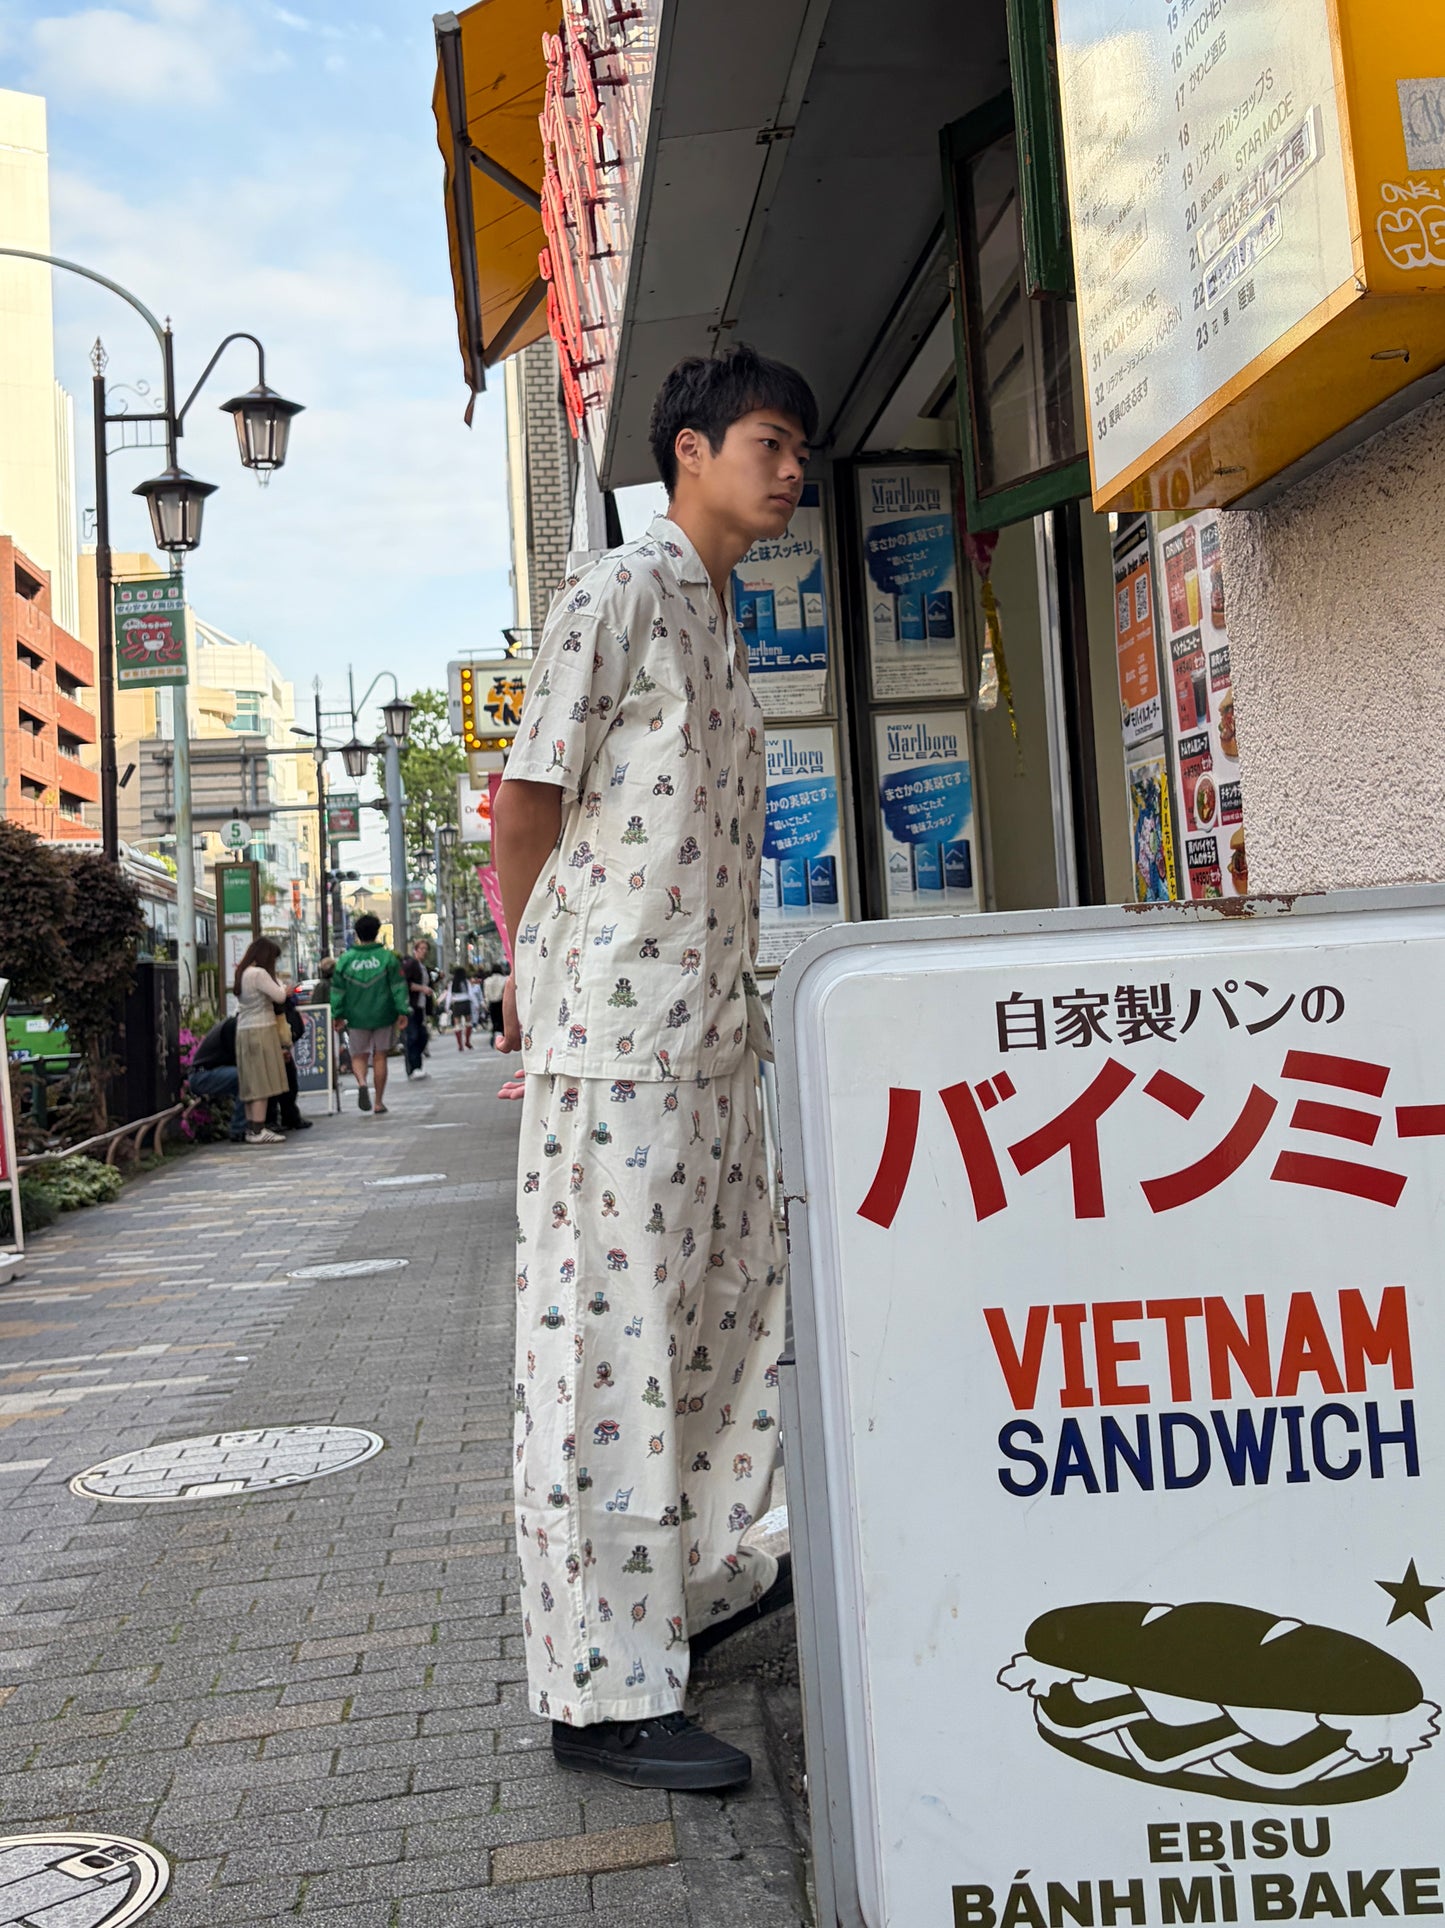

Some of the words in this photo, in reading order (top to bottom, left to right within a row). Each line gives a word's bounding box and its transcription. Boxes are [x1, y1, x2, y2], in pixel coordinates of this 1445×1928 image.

[1170, 45, 1182, 73] 16
[1175, 83, 1185, 112] 17
[1179, 123, 1189, 151] 18
[1185, 201, 1197, 232] 20
[1235, 131, 1261, 171] STAR
[1264, 90, 1294, 141] MODE
[1182, 162, 1193, 190] 19
[1193, 281, 1204, 311] 22
[1196, 322, 1208, 351] 23
[1092, 348, 1101, 372] 31
[1095, 382, 1104, 406] 32
[1098, 416, 1107, 440] 33
[872, 477, 940, 505] Marlboro
[872, 504, 941, 513] CLEAR
[748, 654, 826, 666] CLEAR
[483, 703, 523, 728] てん
[888, 724, 957, 753] Marlboro
[768, 739, 824, 767] arlboro
[888, 750, 958, 761] CLEAR
[768, 766, 824, 775] LEAR
[885, 772, 968, 801] まさかの実現です。
[231, 823, 241, 838] 5
[351, 957, 381, 971] Grab
[995, 981, 1345, 1053] 自家製パンの
[983, 1286, 1414, 1410] VIETNAM
[997, 1400, 1421, 1497] SANDWICH
[1147, 1816, 1331, 1863] EBISU
[951, 1869, 1146, 1928] BÁNH
[1158, 1862, 1238, 1924] MÌ
[1250, 1867, 1445, 1921] BAKE
